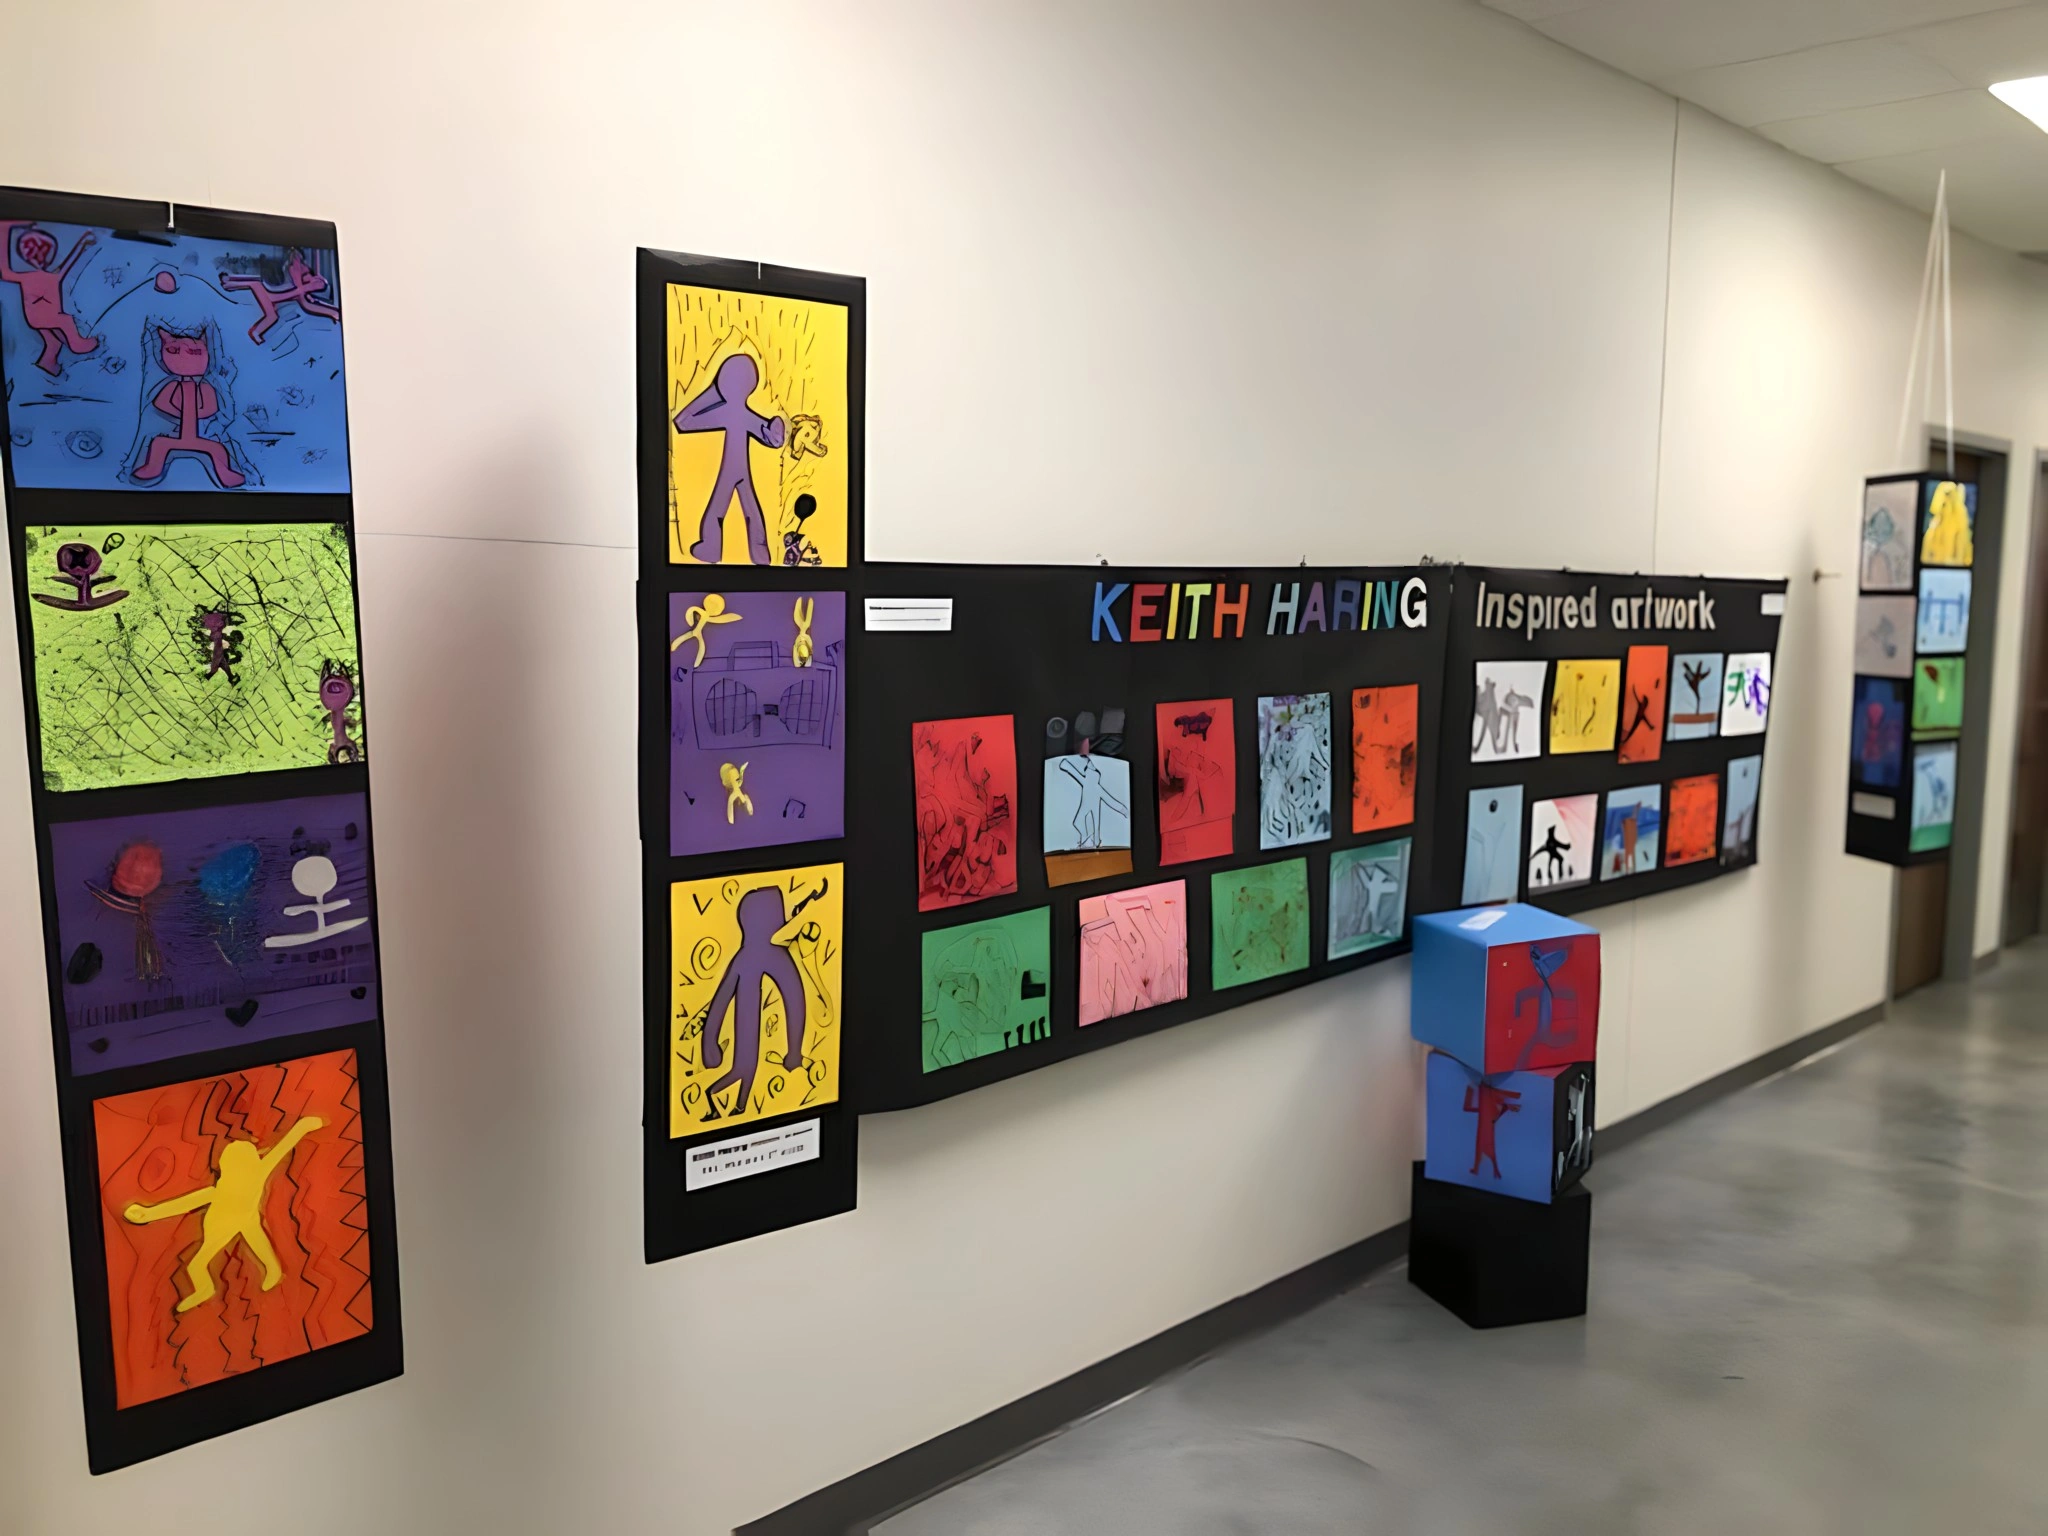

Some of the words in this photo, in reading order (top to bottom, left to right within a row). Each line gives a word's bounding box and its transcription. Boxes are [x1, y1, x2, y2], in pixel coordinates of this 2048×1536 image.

[1091, 581, 1250, 642] KEITH
[1266, 577, 1427, 635] HARING
[1476, 581, 1597, 641] Inspired
[1611, 588, 1716, 630] artwork
